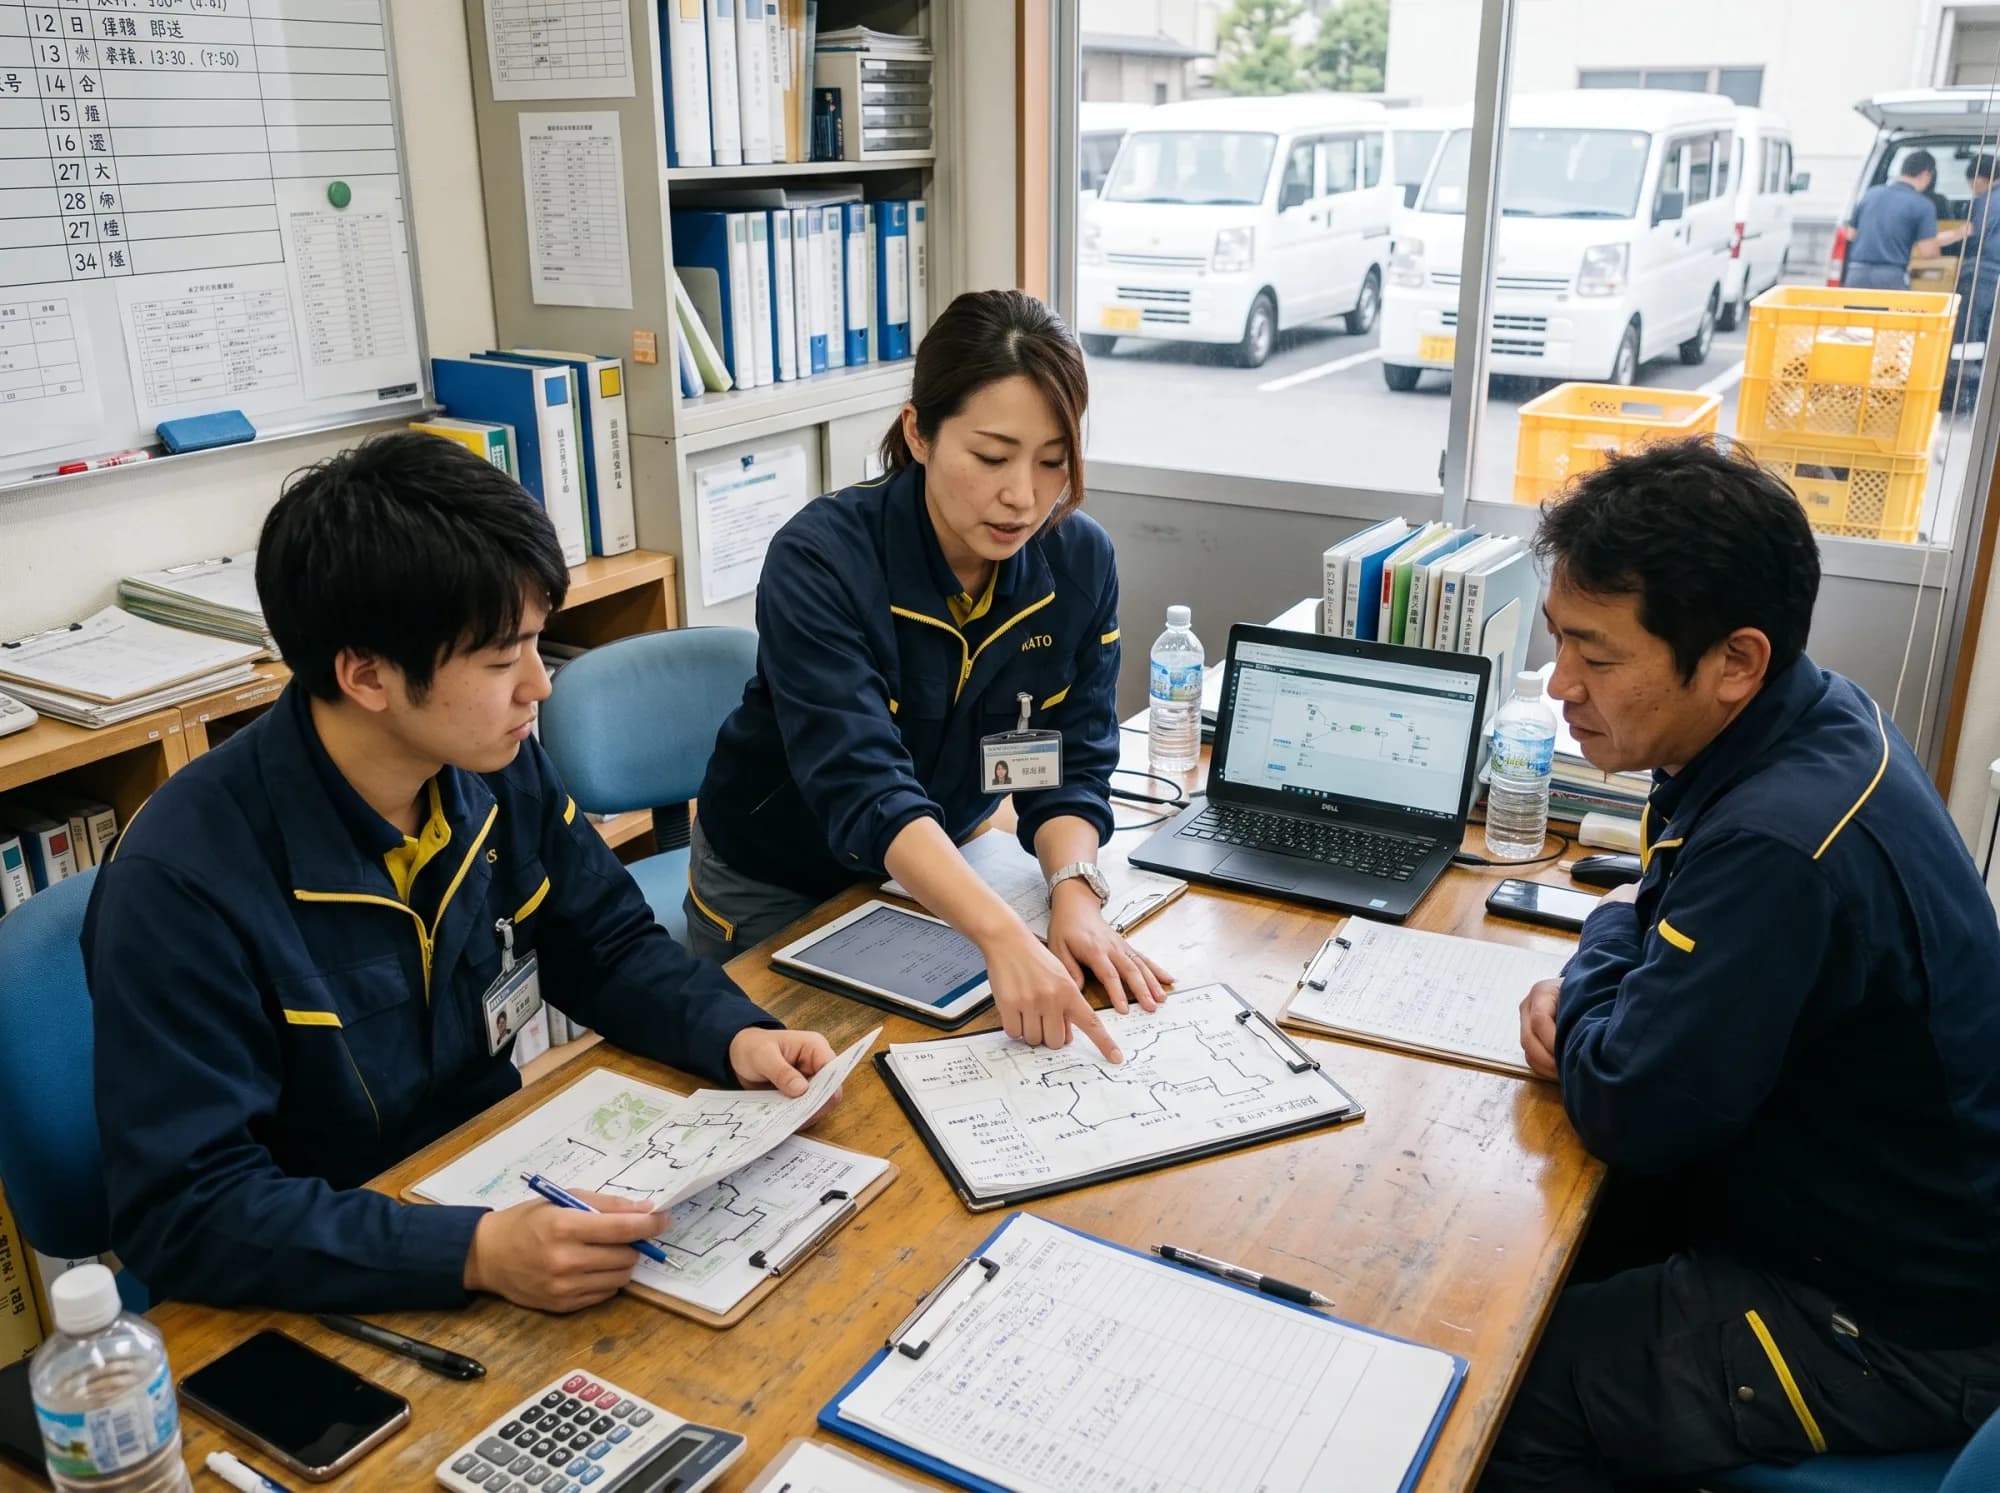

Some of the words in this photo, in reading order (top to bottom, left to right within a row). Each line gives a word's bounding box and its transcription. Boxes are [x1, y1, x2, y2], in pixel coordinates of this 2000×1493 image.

[35, 14, 57, 33] 12
[72, 17, 84, 33] 日
[40, 45, 61, 63] 13
[46, 75, 66, 93] 14
[51, 104, 71, 122] 15
[56, 134, 76, 151] 16
[58, 163, 80, 181] 27
[94, 162, 111, 179] 大
[64, 192, 86, 210] 28
[69, 221, 89, 239] 27
[74, 253, 97, 271] 34
